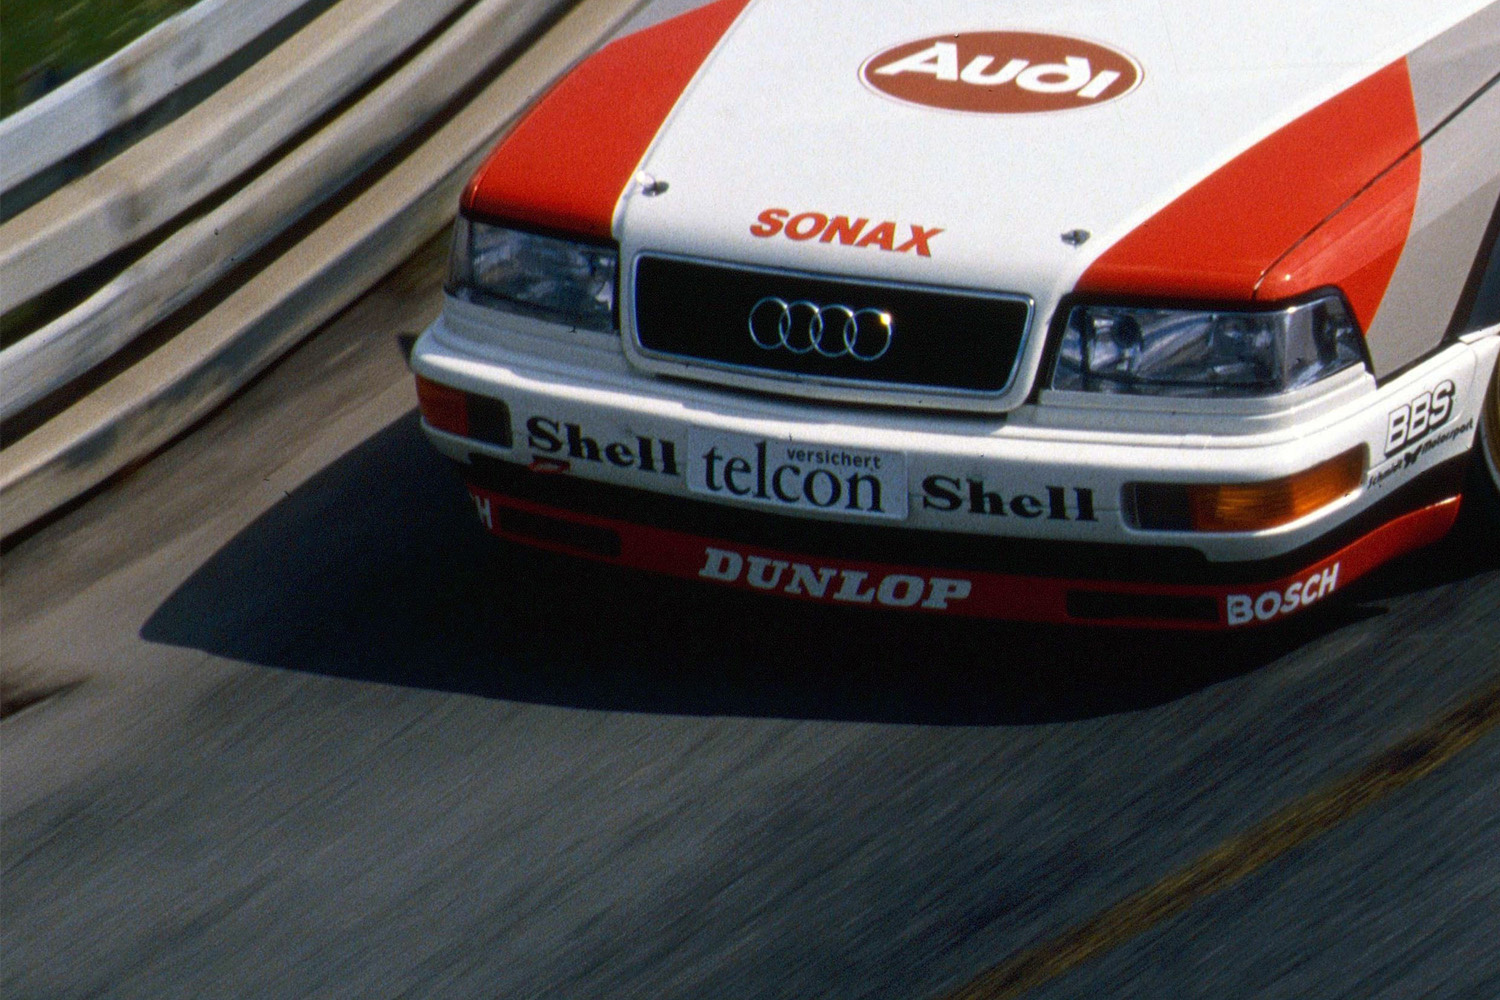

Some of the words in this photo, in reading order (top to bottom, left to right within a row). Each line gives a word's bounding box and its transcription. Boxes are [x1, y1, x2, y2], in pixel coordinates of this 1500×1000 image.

[877, 41, 1123, 99] Audi
[749, 208, 945, 257] SONAX
[527, 416, 680, 477] Shell
[1384, 379, 1457, 458] BBS
[702, 440, 886, 513] telcon
[786, 448, 882, 470] versichert
[922, 475, 1099, 522] Shell
[699, 547, 972, 609] DUNLOP
[1226, 562, 1340, 626] BOSCH
